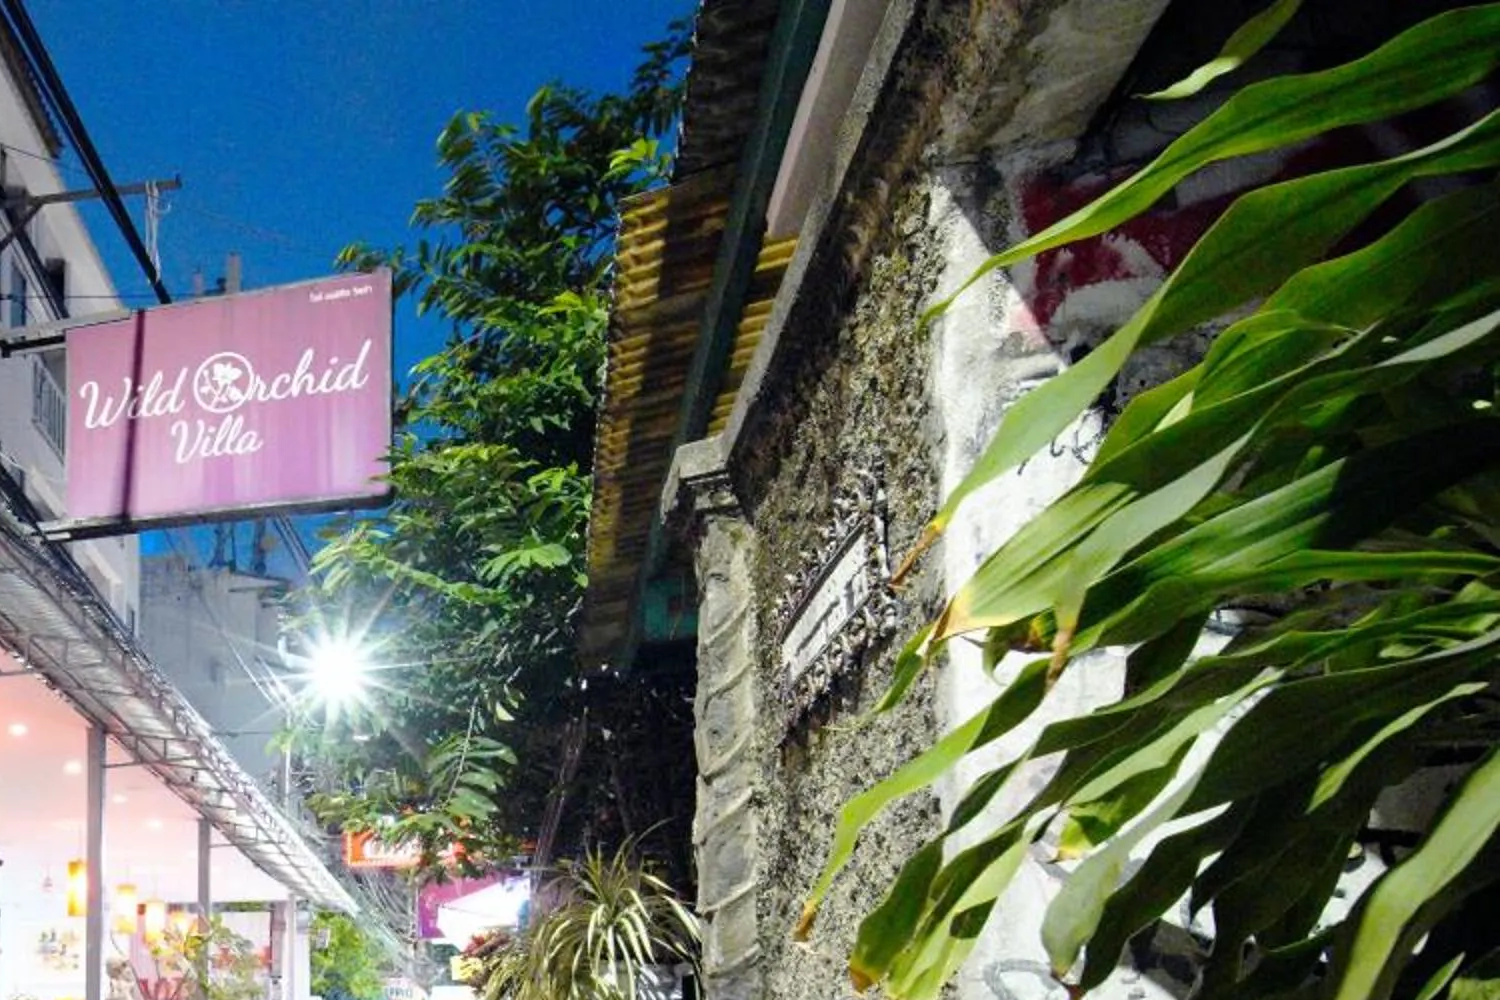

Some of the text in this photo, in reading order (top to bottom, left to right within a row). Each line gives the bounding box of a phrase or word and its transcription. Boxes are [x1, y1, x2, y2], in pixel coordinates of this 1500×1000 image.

[79, 338, 373, 429] Wild Orchid
[170, 414, 263, 464] Villa
